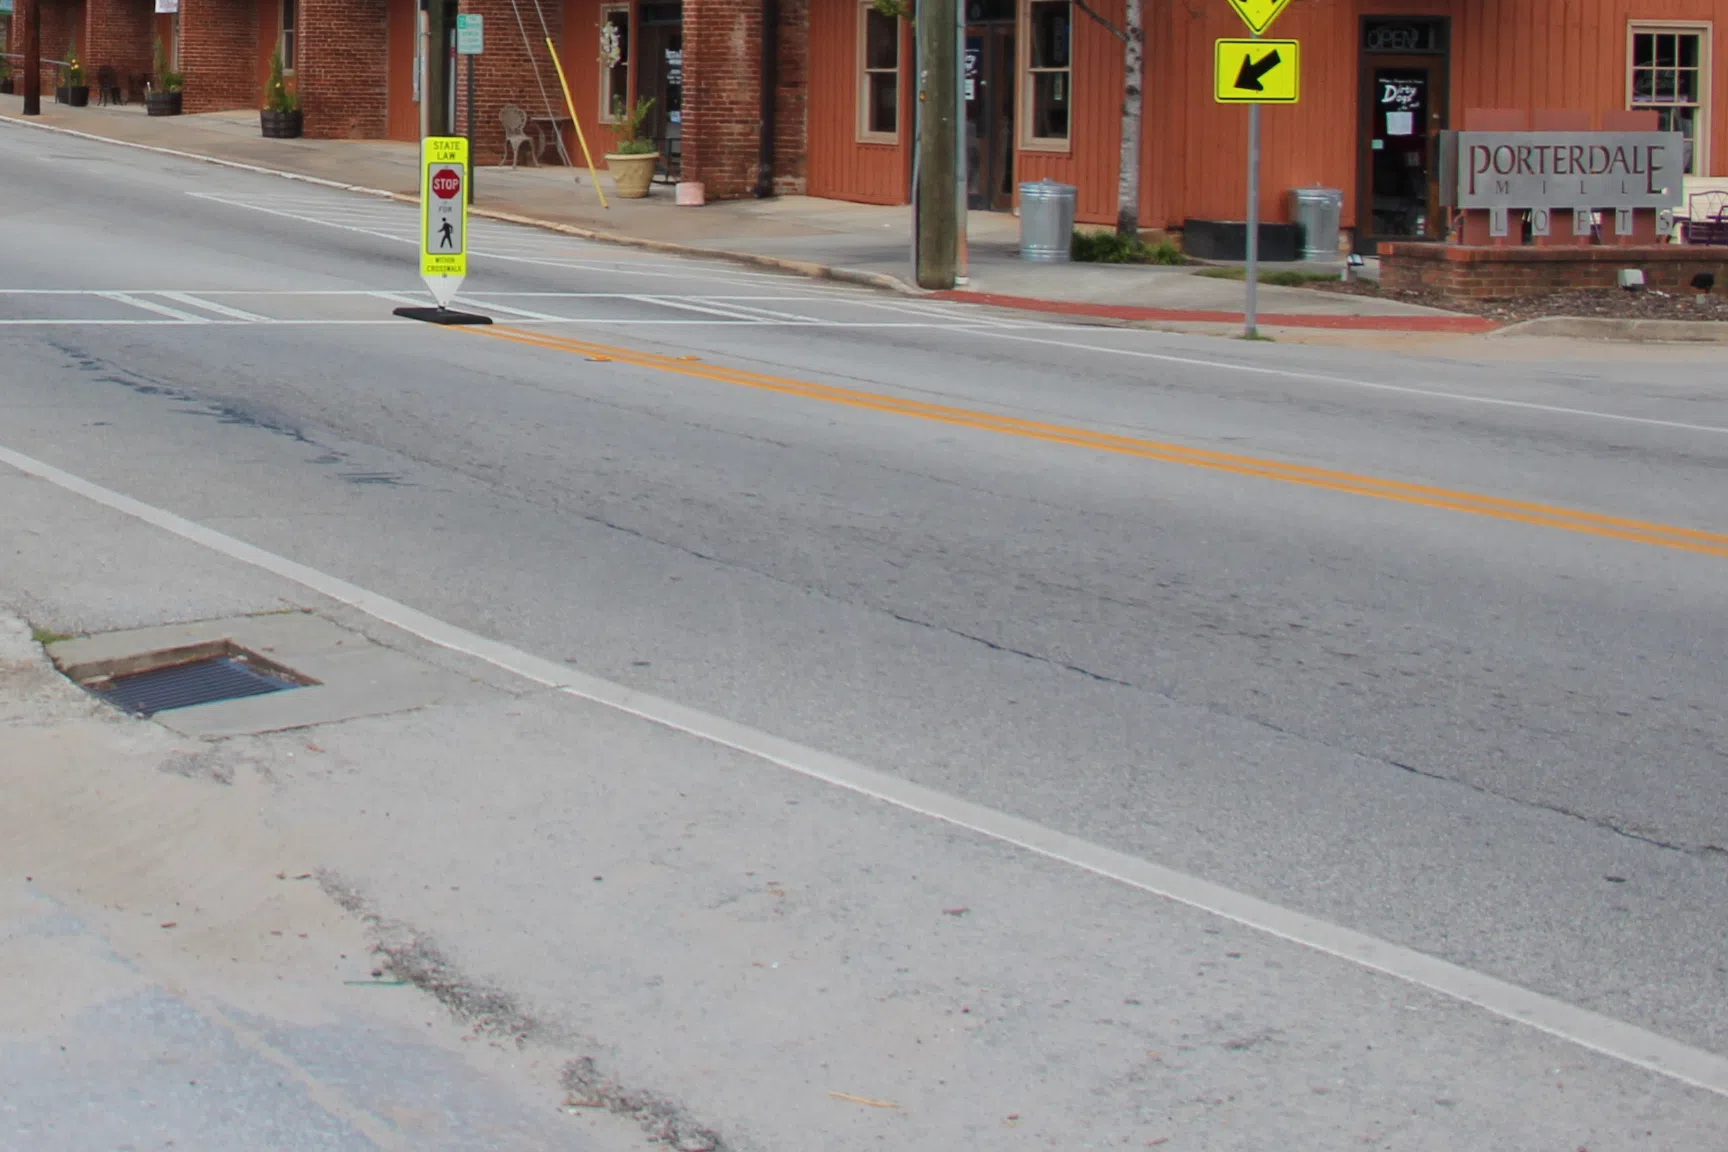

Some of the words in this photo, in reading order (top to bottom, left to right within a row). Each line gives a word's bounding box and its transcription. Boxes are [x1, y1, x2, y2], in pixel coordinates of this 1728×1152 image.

[433, 141, 461, 150] STATE
[437, 152, 456, 160] LAW
[1468, 145, 1666, 195] PORTERDALE
[433, 178, 459, 190] STOP
[1495, 180, 1629, 195] MILL
[1494, 208, 1672, 232] LOFTS
